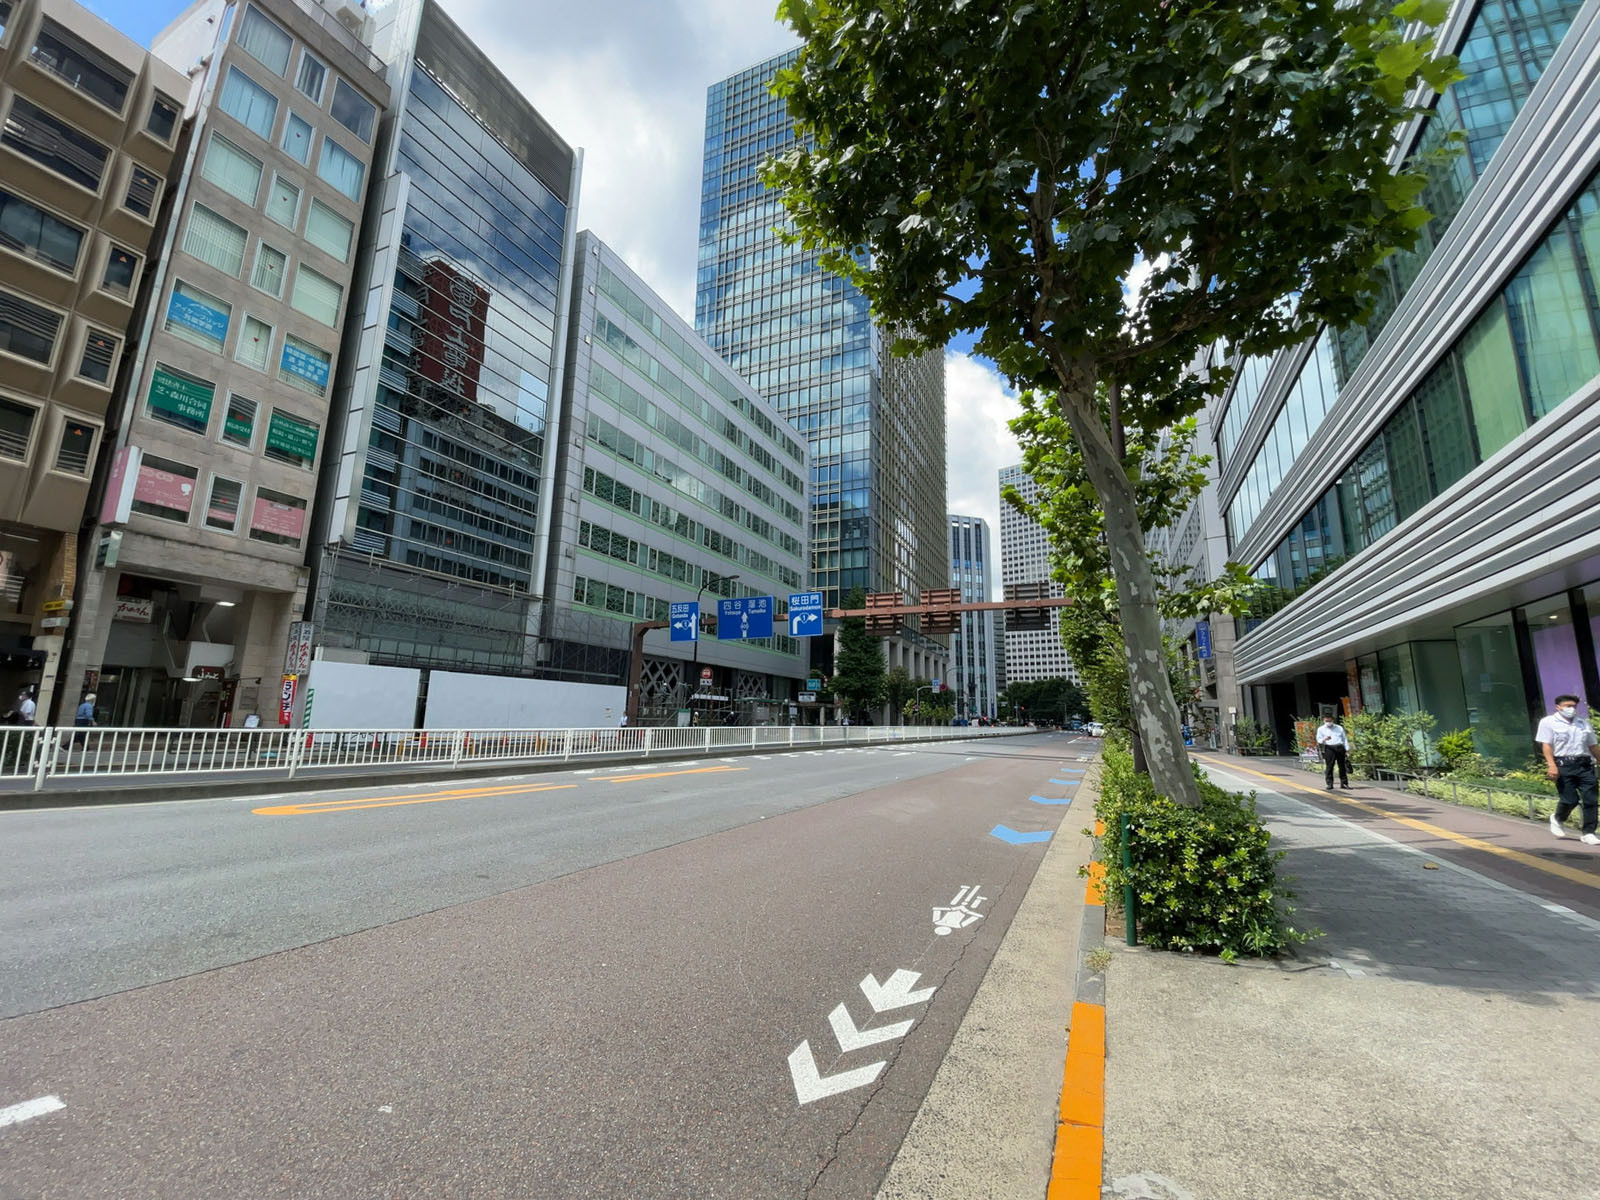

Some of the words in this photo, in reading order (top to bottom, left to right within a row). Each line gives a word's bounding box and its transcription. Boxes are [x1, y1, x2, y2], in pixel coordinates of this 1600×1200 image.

[177, 403, 206, 419] 事務所
[723, 600, 742, 611] 四谷
[791, 594, 819, 606] 桜田門
[671, 603, 689, 613] 五反田
[282, 681, 294, 710] ランチ
